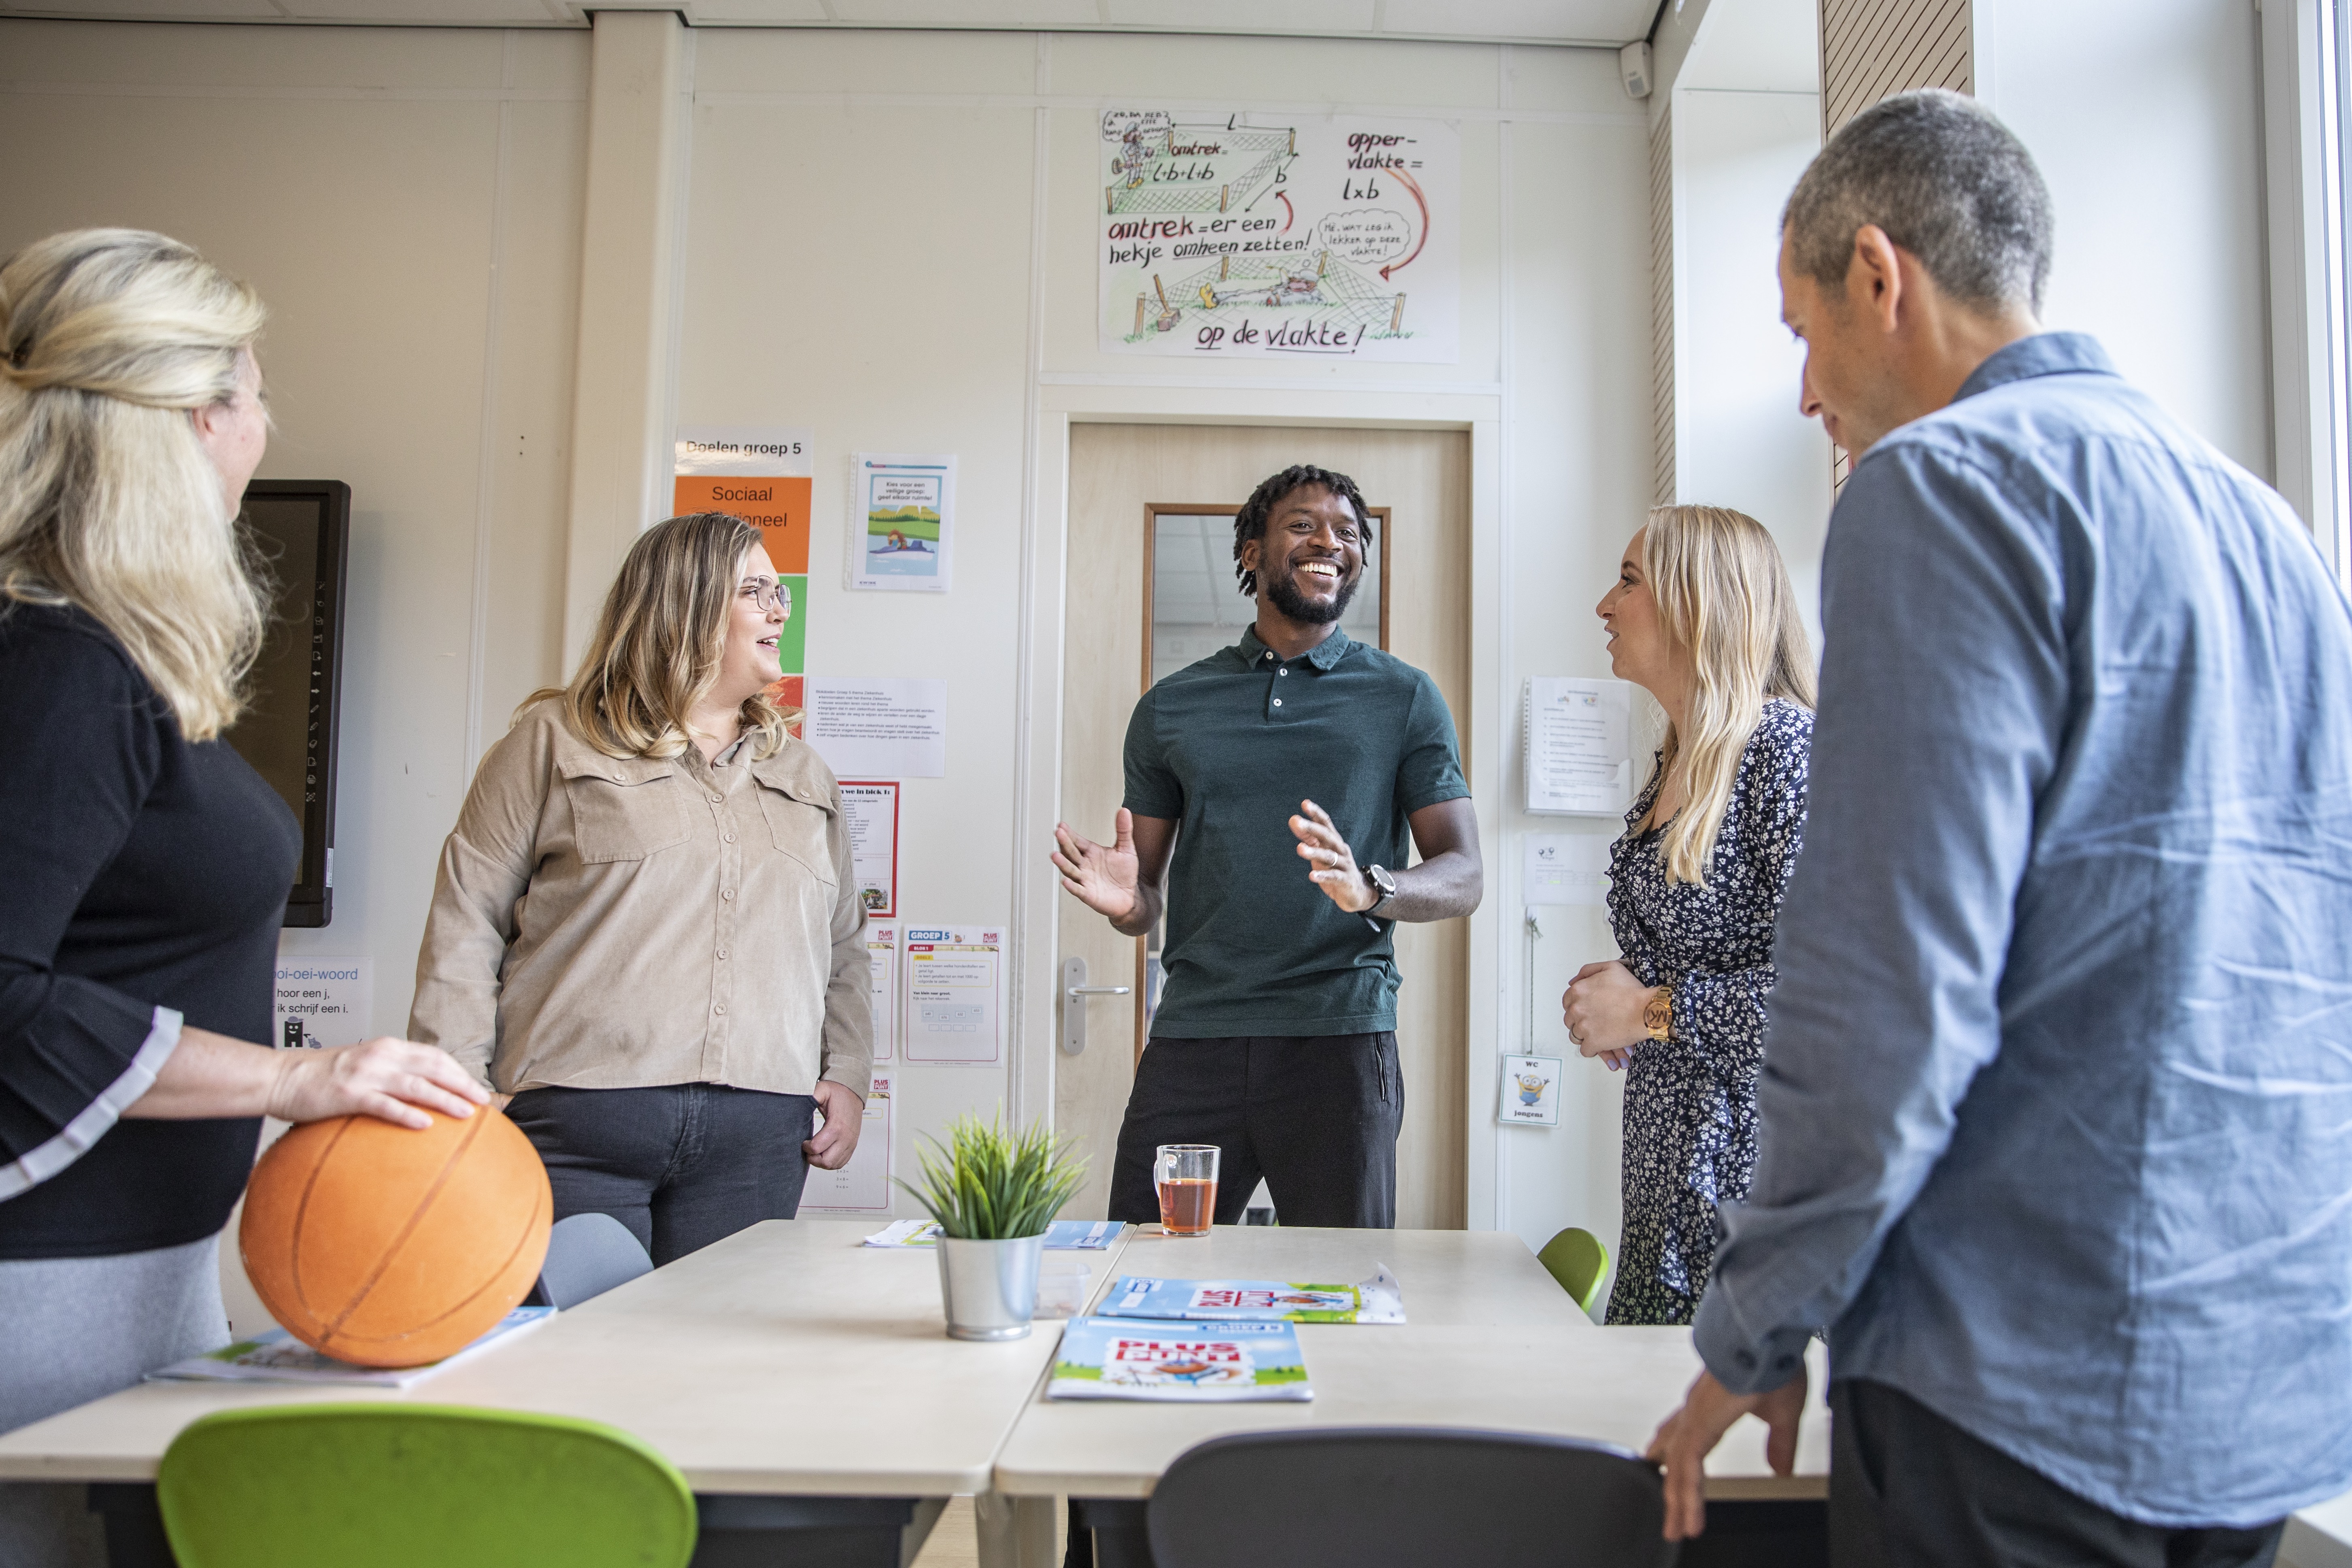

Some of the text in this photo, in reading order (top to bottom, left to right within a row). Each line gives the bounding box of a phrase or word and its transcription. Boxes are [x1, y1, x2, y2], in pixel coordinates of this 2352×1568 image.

[1348, 151, 1405, 170] vlakte
[1108, 215, 1194, 240] omtrek
[1211, 219, 1237, 233] er
[1242, 217, 1276, 231] een
[1110, 228, 1313, 268] hekje omheen zetten!
[1197, 326, 1225, 349] op
[1233, 319, 1259, 344] de
[687, 440, 801, 457] Doelen groep 5
[712, 486, 772, 501] Sociaal
[277, 989, 300, 997] hoor
[324, 989, 330, 1000] j,
[277, 1004, 285, 1013] ik
[289, 1004, 319, 1015] schrijf
[343, 1004, 348, 1013] i.
[1119, 1340, 1237, 1353] PLUS
